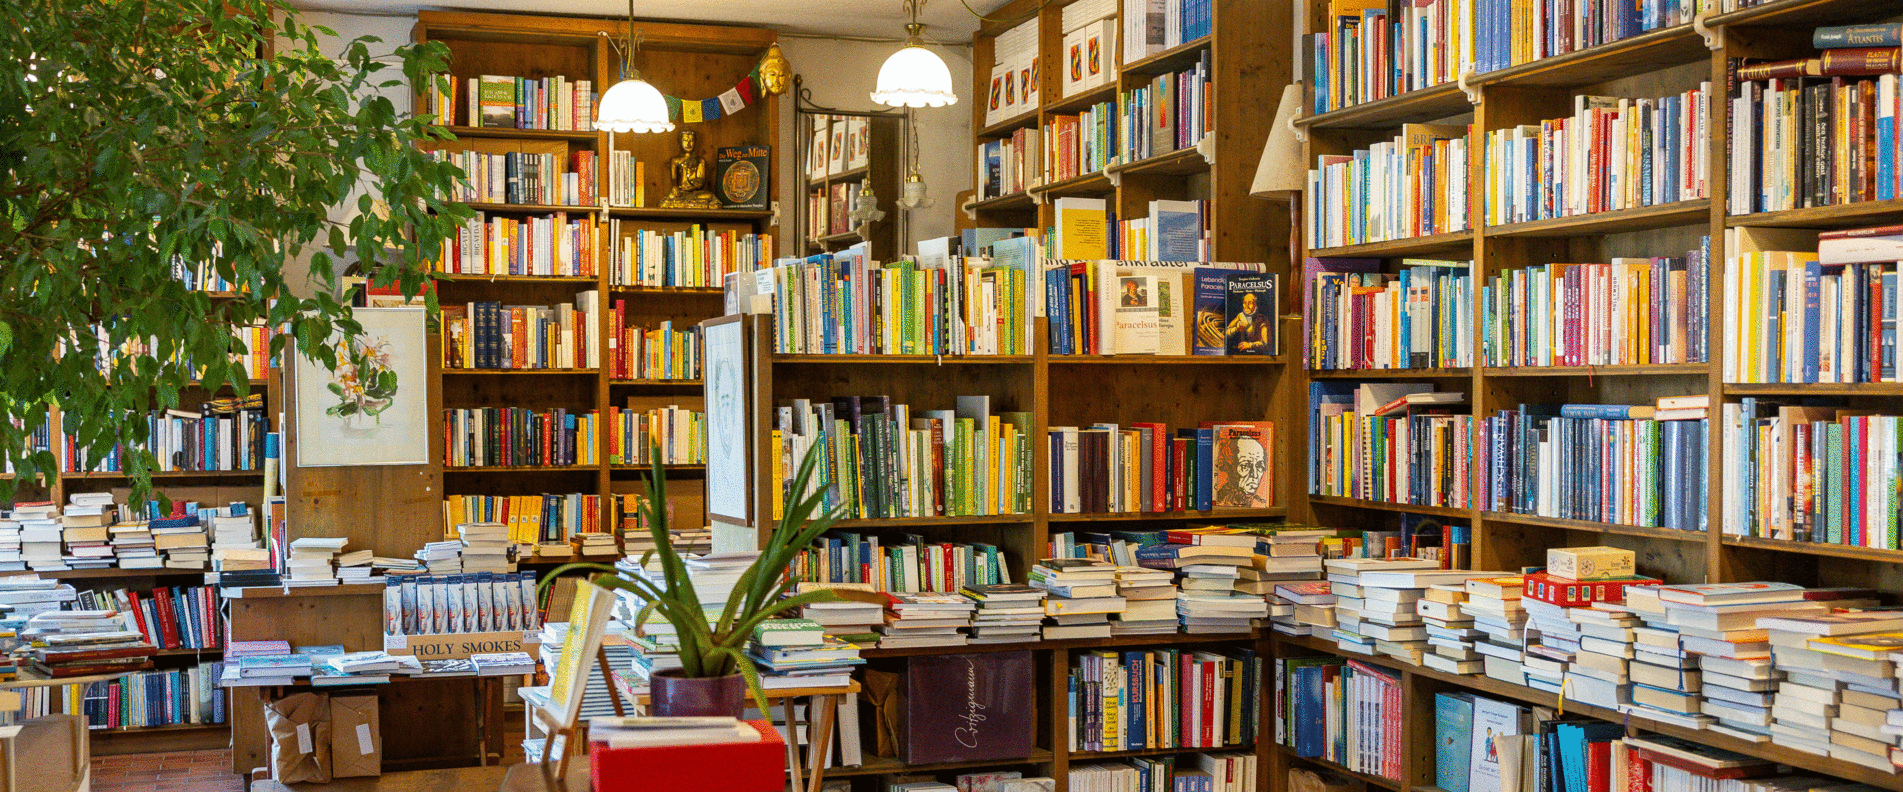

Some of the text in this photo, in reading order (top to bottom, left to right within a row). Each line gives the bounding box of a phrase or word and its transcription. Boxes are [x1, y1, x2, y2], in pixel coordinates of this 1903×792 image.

[1847, 34, 1883, 44] ATLANTIS
[726, 149, 742, 160] Weg
[748, 148, 767, 158] Mitte
[1229, 279, 1273, 290] PARACELSUS
[413, 640, 521, 656] HOLY SMOKES
